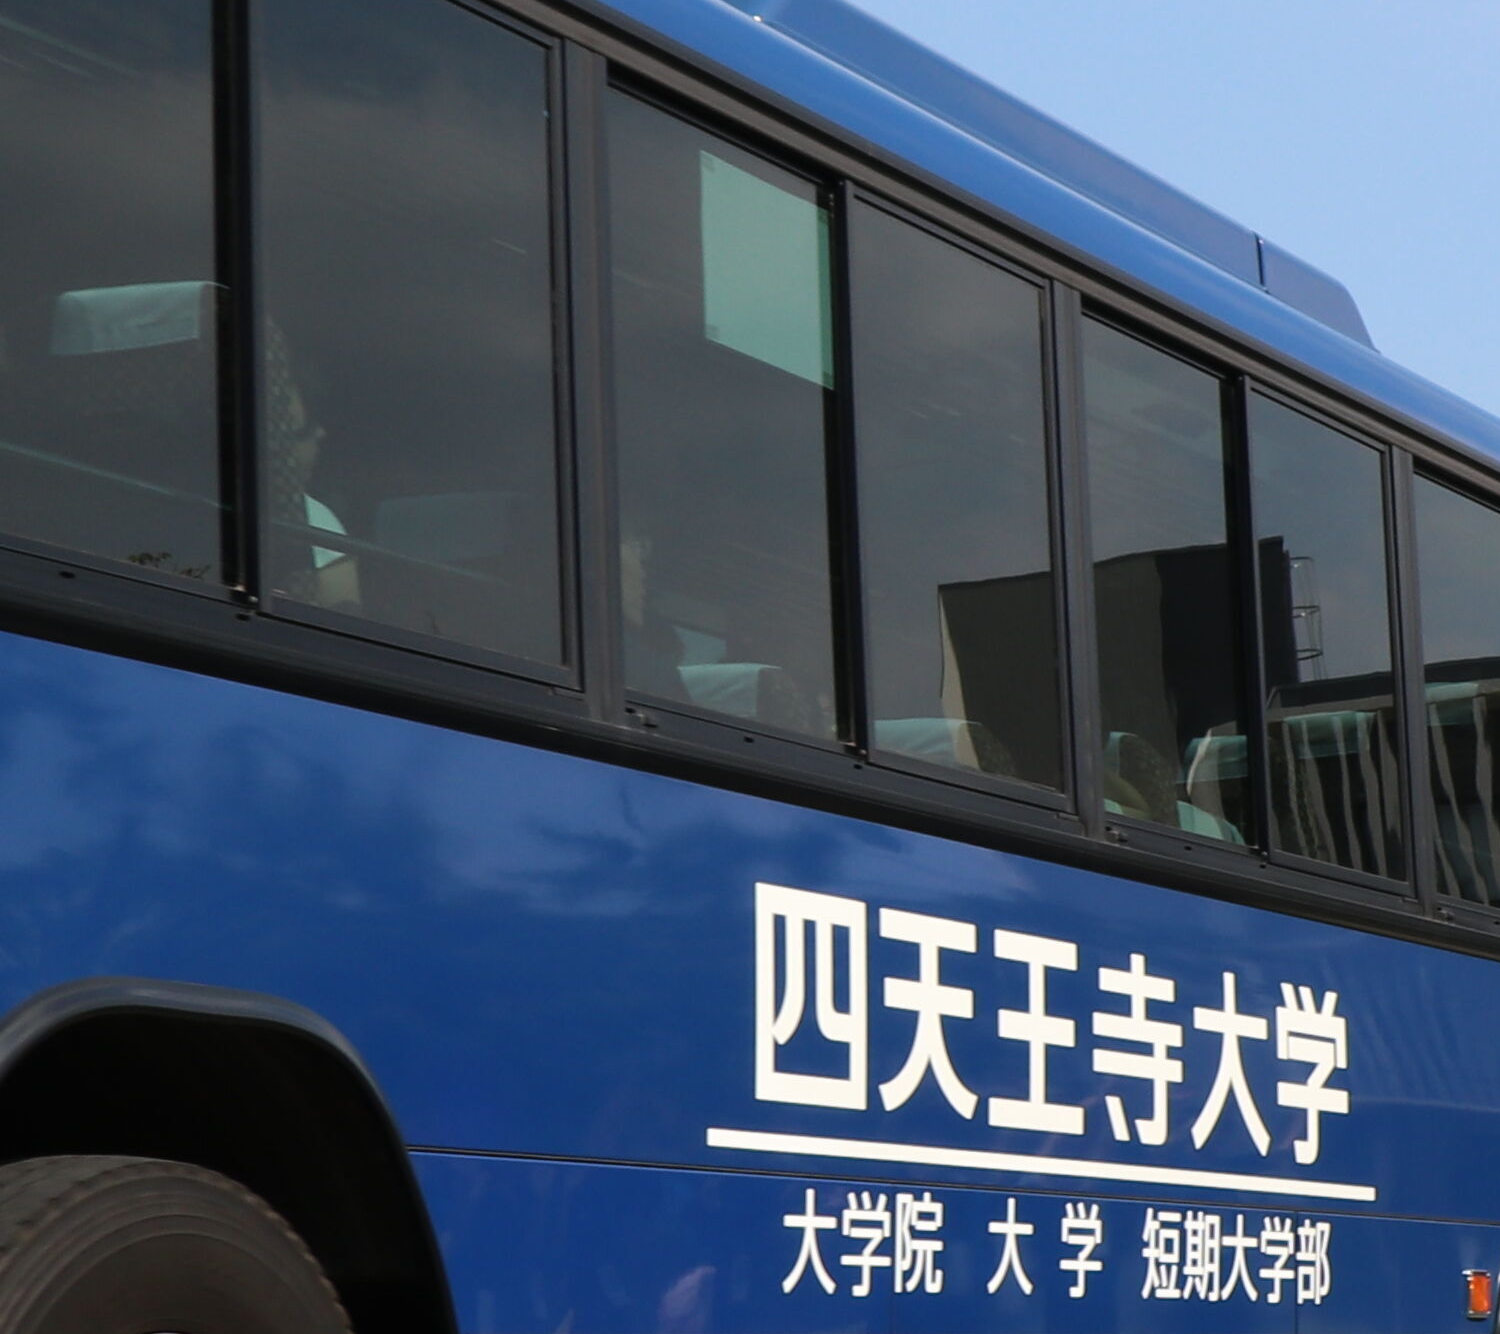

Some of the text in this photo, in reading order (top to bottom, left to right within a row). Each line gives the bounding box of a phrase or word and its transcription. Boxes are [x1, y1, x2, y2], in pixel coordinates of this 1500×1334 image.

[756, 883, 1349, 1165] 四天王寺大学
[783, 1189, 943, 1296] 大学院
[1142, 1208, 1331, 1305] 短期大学部
